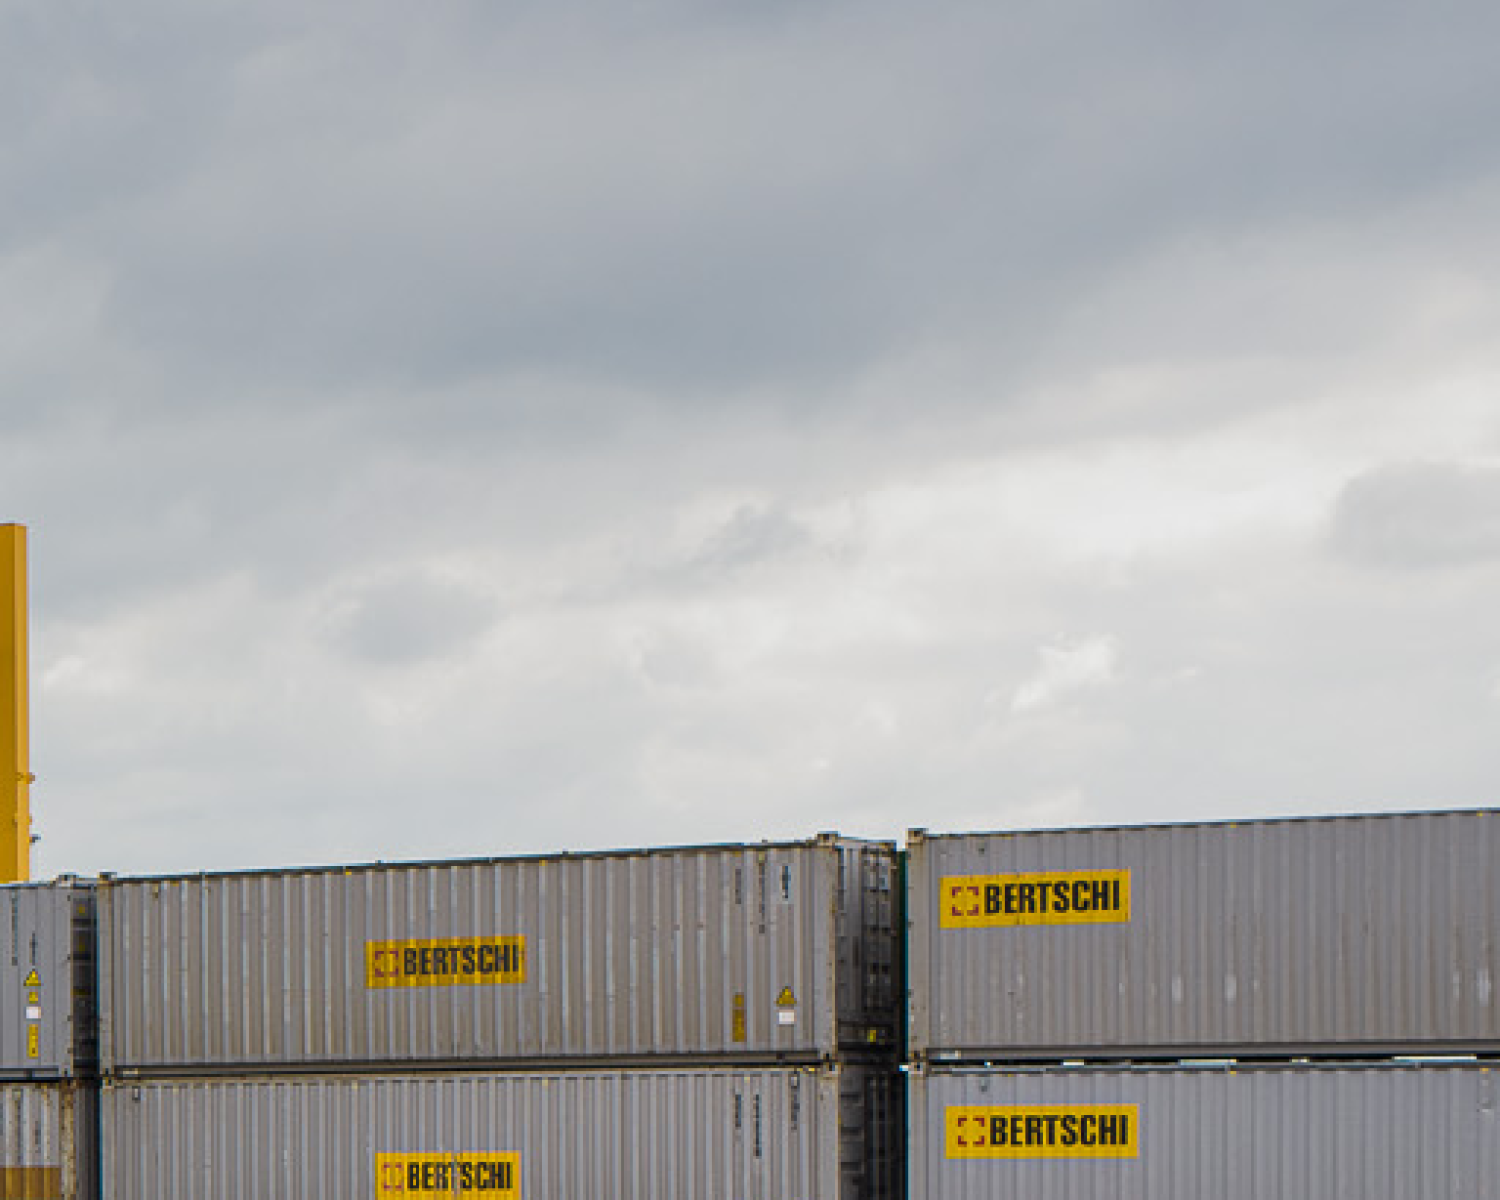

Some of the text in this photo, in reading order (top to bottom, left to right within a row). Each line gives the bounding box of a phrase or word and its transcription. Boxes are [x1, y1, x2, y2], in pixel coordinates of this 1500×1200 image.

[984, 879, 1121, 915] BERTSCHI
[403, 943, 519, 978] BERTSCHI
[990, 1114, 1129, 1147] BERTSCHI
[406, 1159, 513, 1192] BERTSCHI
